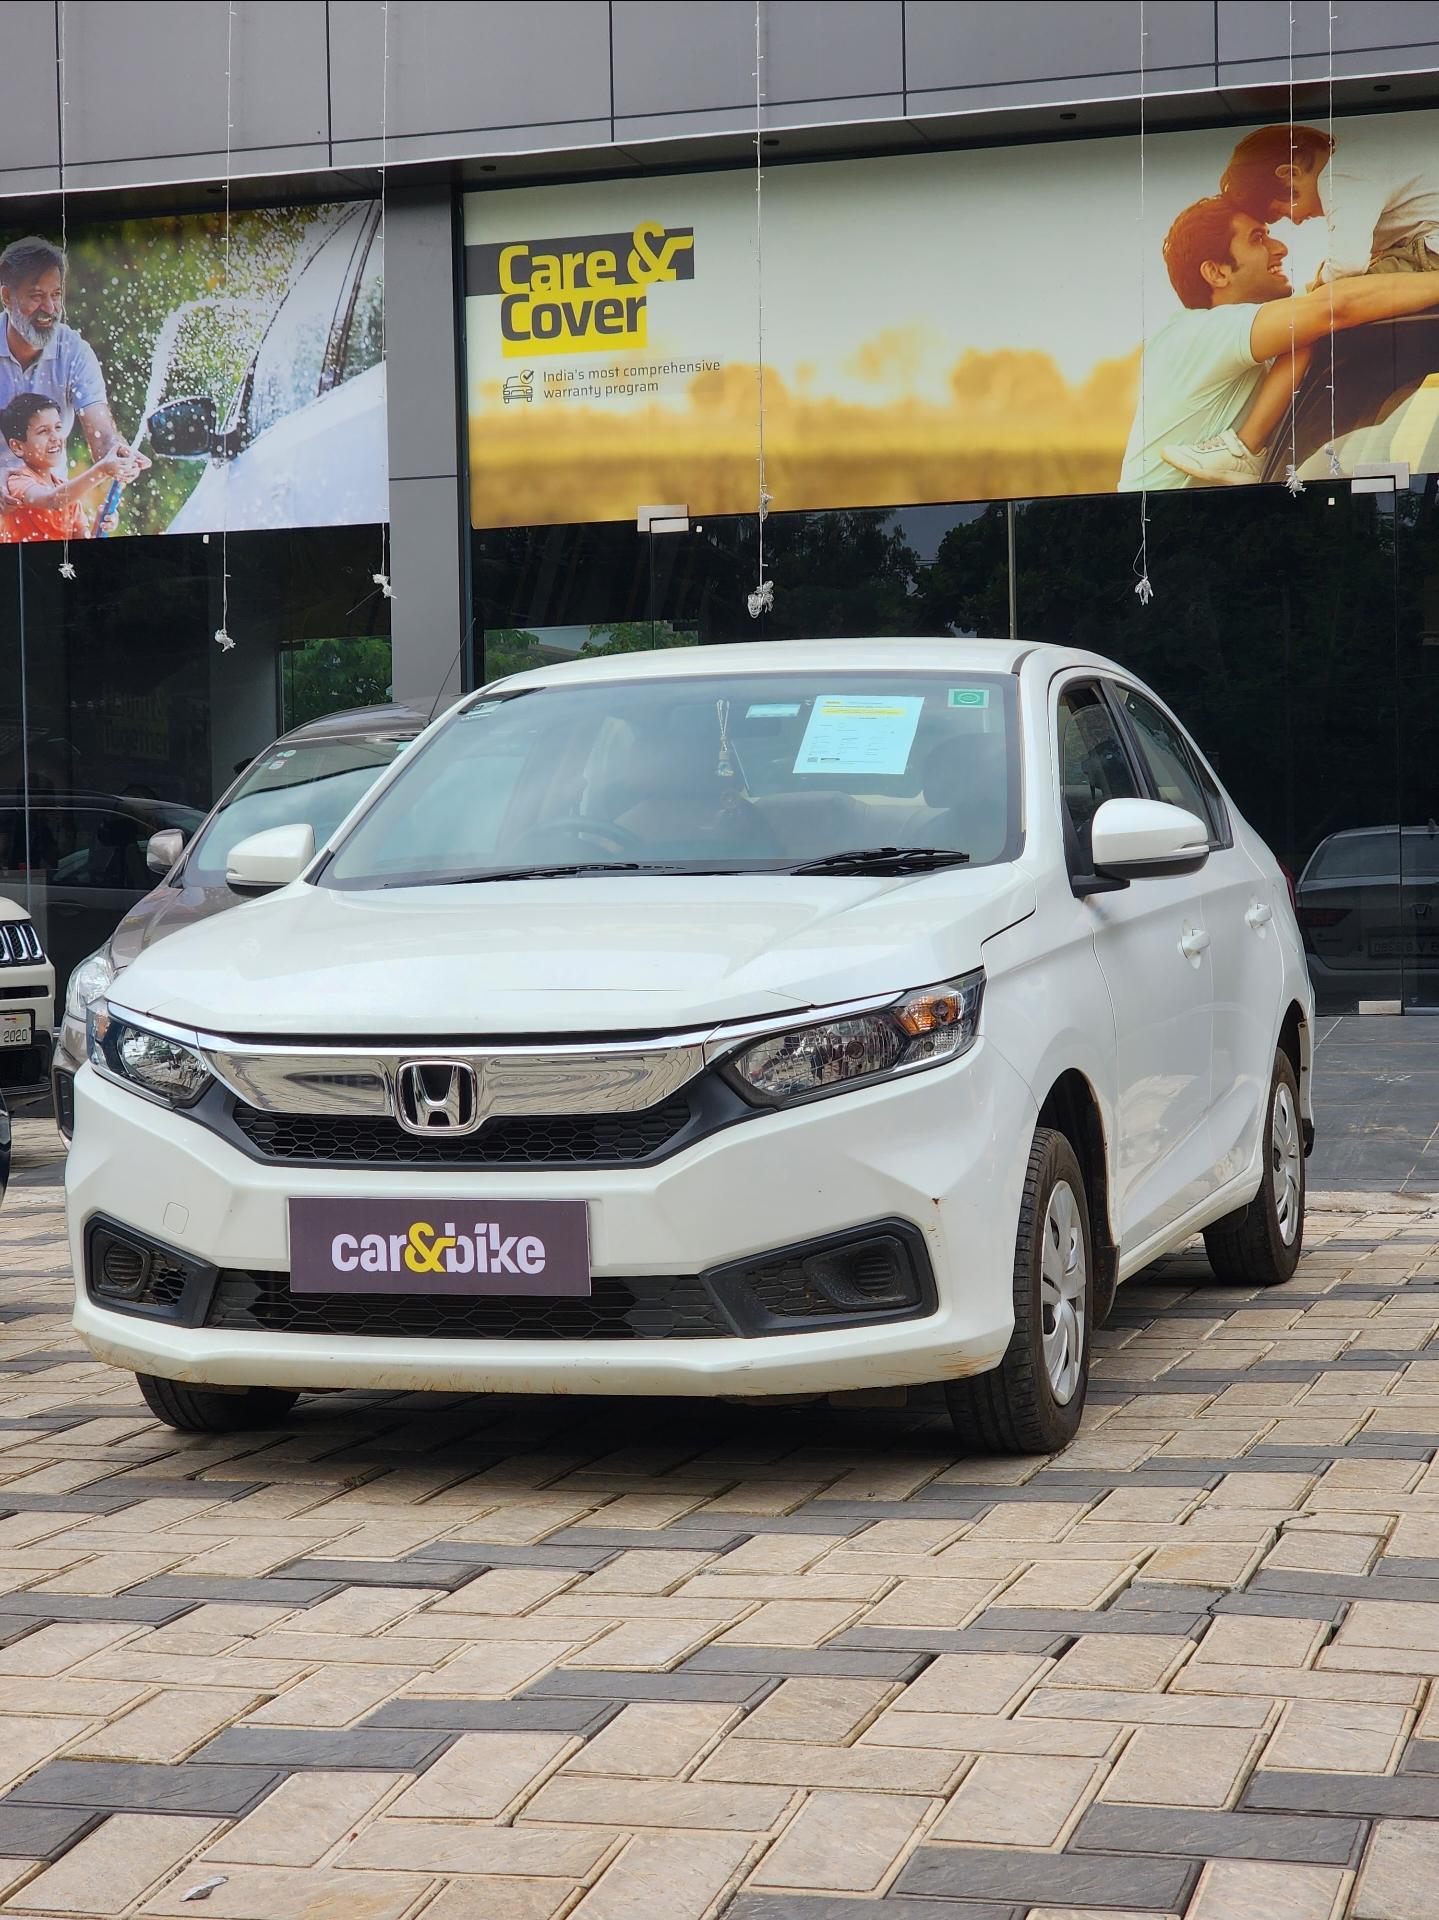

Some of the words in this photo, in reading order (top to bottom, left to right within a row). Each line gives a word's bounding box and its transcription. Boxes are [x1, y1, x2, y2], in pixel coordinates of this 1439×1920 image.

[499, 245, 617, 294] Care
[627, 220, 694, 283] &
[501, 292, 647, 341] Cover
[543, 369, 585, 383] India's
[588, 366, 620, 379] most
[623, 359, 721, 379] comprehensive
[543, 384, 601, 400] warranty
[605, 380, 659, 396] program
[3, 1029, 28, 1042] 2020
[331, 1222, 546, 1275] car&bike
